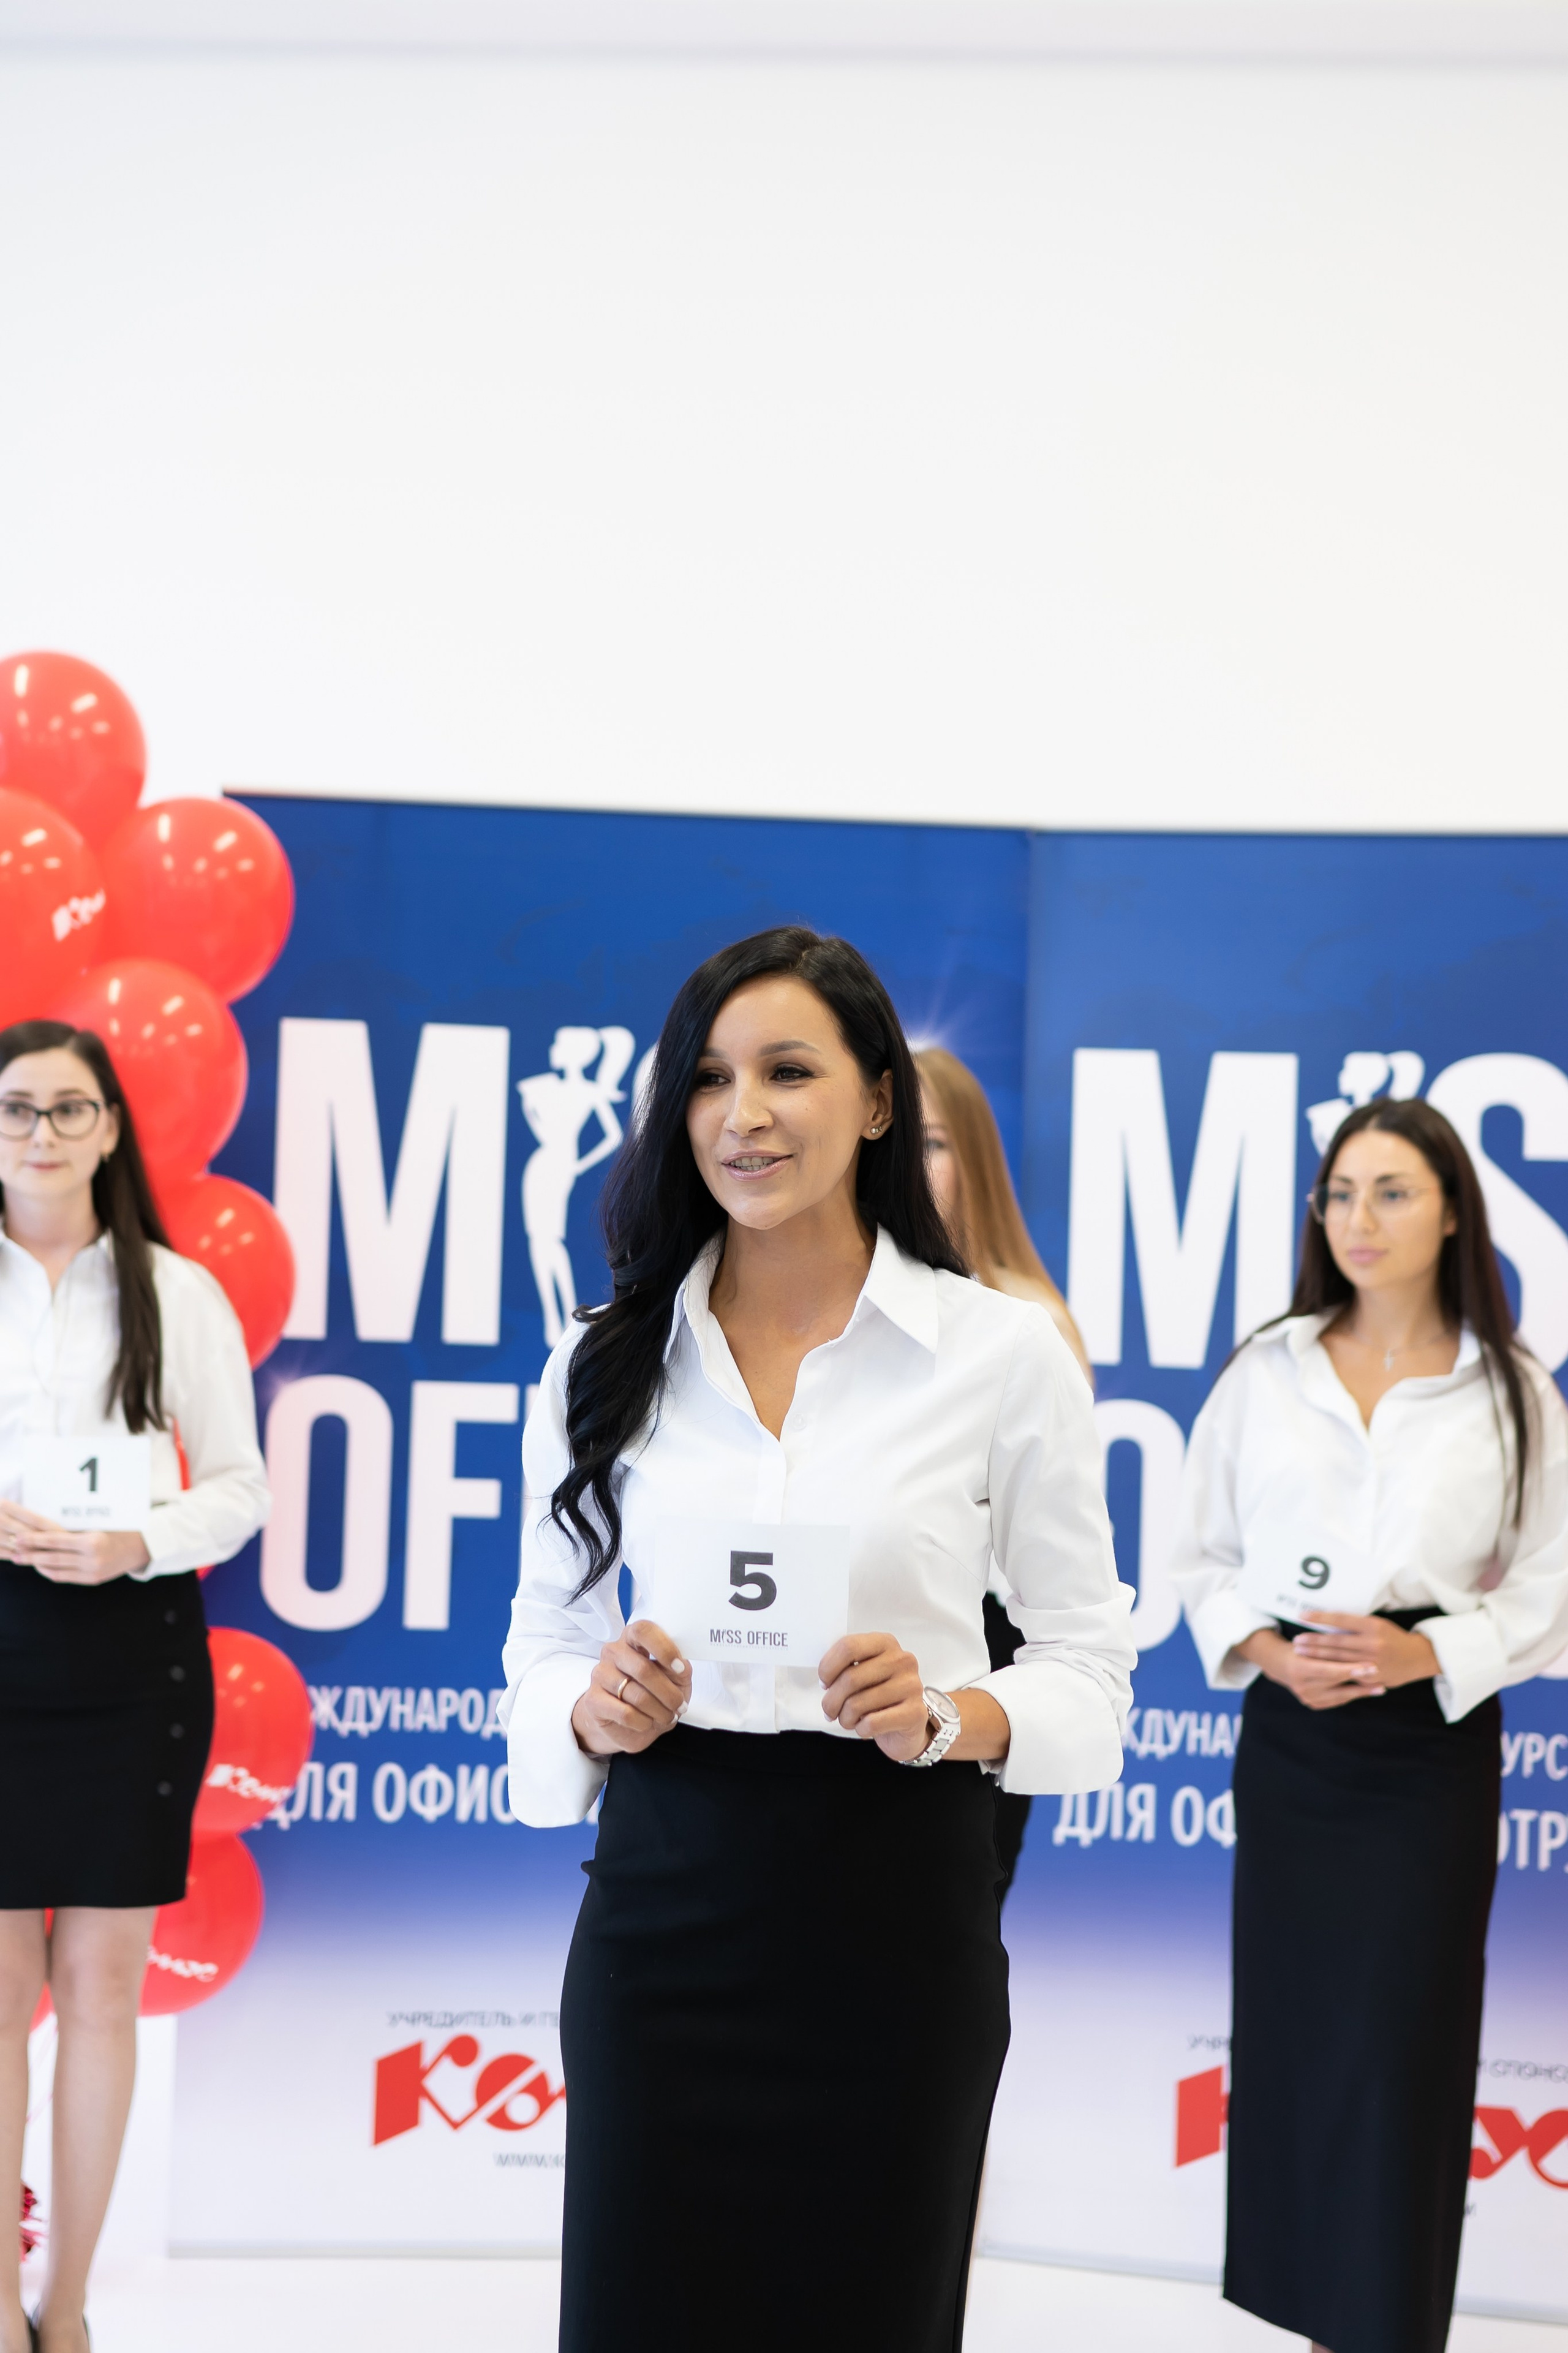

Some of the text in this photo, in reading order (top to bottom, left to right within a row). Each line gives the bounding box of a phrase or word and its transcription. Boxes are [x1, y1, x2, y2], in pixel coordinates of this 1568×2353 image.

[79, 1456, 98, 1493] 1
[260, 1373, 542, 1631] OF
[728, 1550, 777, 1611] 5
[1297, 1555, 1331, 1590] 9
[747, 1631, 789, 1647] OFFICE
